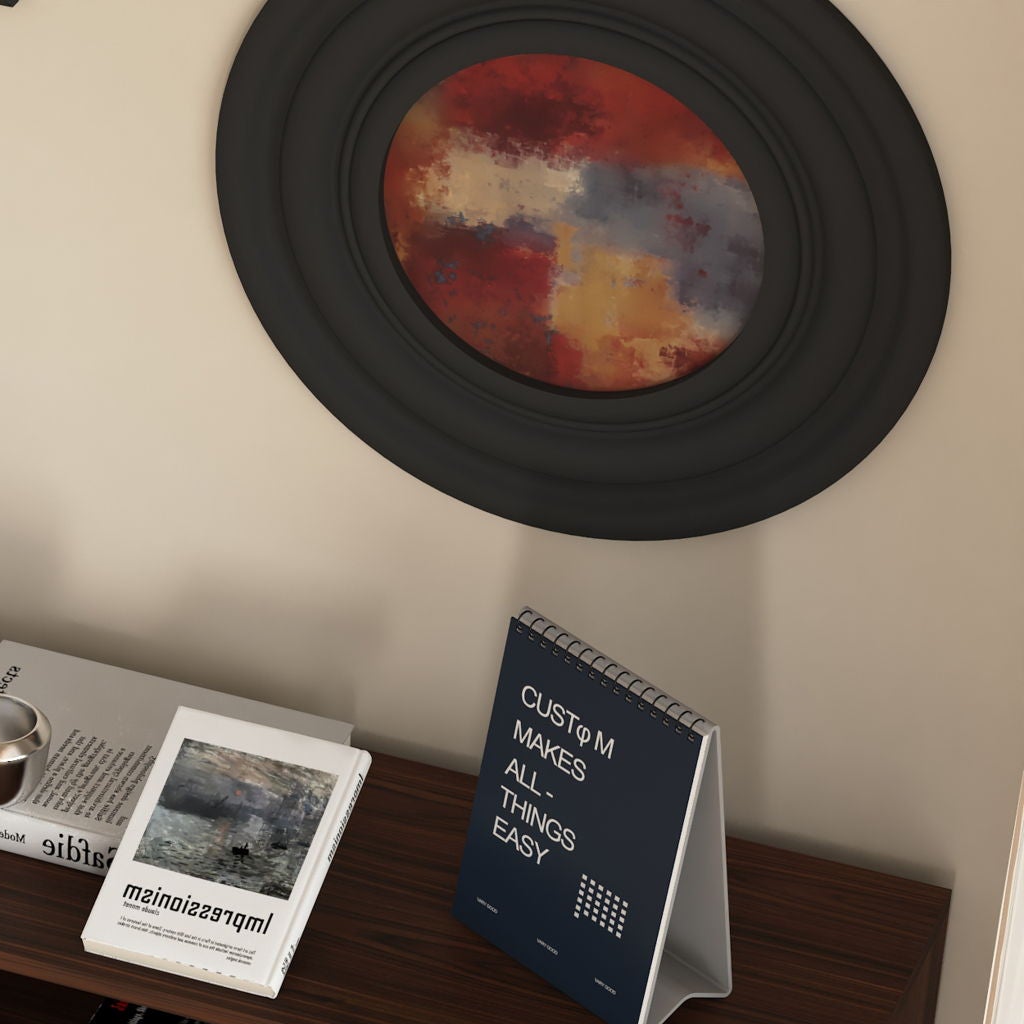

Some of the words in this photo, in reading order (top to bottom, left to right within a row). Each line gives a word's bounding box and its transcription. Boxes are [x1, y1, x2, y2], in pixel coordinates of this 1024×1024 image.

[513, 719, 587, 782] MAKES
[492, 815, 550, 865] EASY
[501, 785, 576, 852] THINGS
